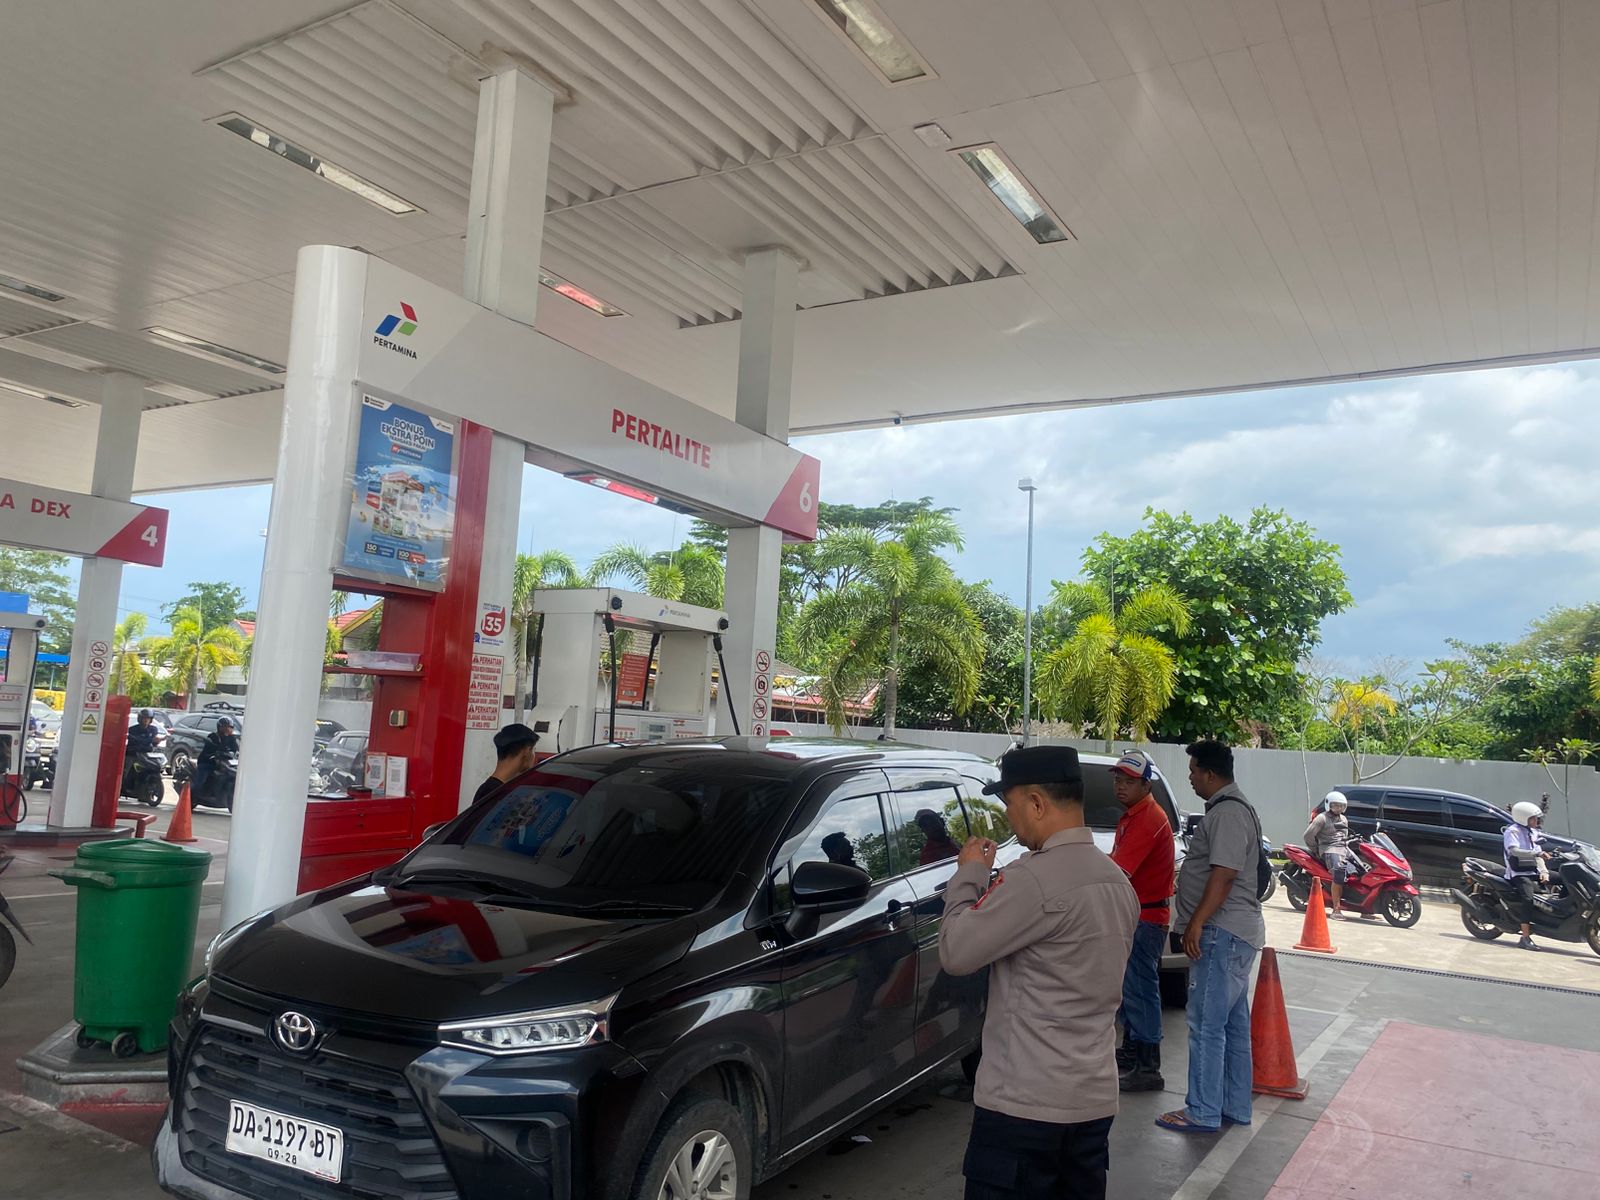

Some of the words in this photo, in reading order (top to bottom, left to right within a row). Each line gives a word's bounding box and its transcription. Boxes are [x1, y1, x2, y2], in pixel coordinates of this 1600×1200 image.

[373, 336, 418, 359] PERTAMINA
[381, 423, 412, 441] EKSTRA
[413, 434, 435, 449] POIN
[394, 418, 425, 436] BONUS
[611, 408, 713, 469] PERTALITE
[30, 498, 72, 519] DEX
[799, 481, 813, 513] 6
[141, 525, 158, 547] 4
[481, 614, 502, 633] 135
[232, 1106, 256, 1138] DA
[262, 1116, 308, 1151] 1197
[313, 1129, 337, 1161] BT
